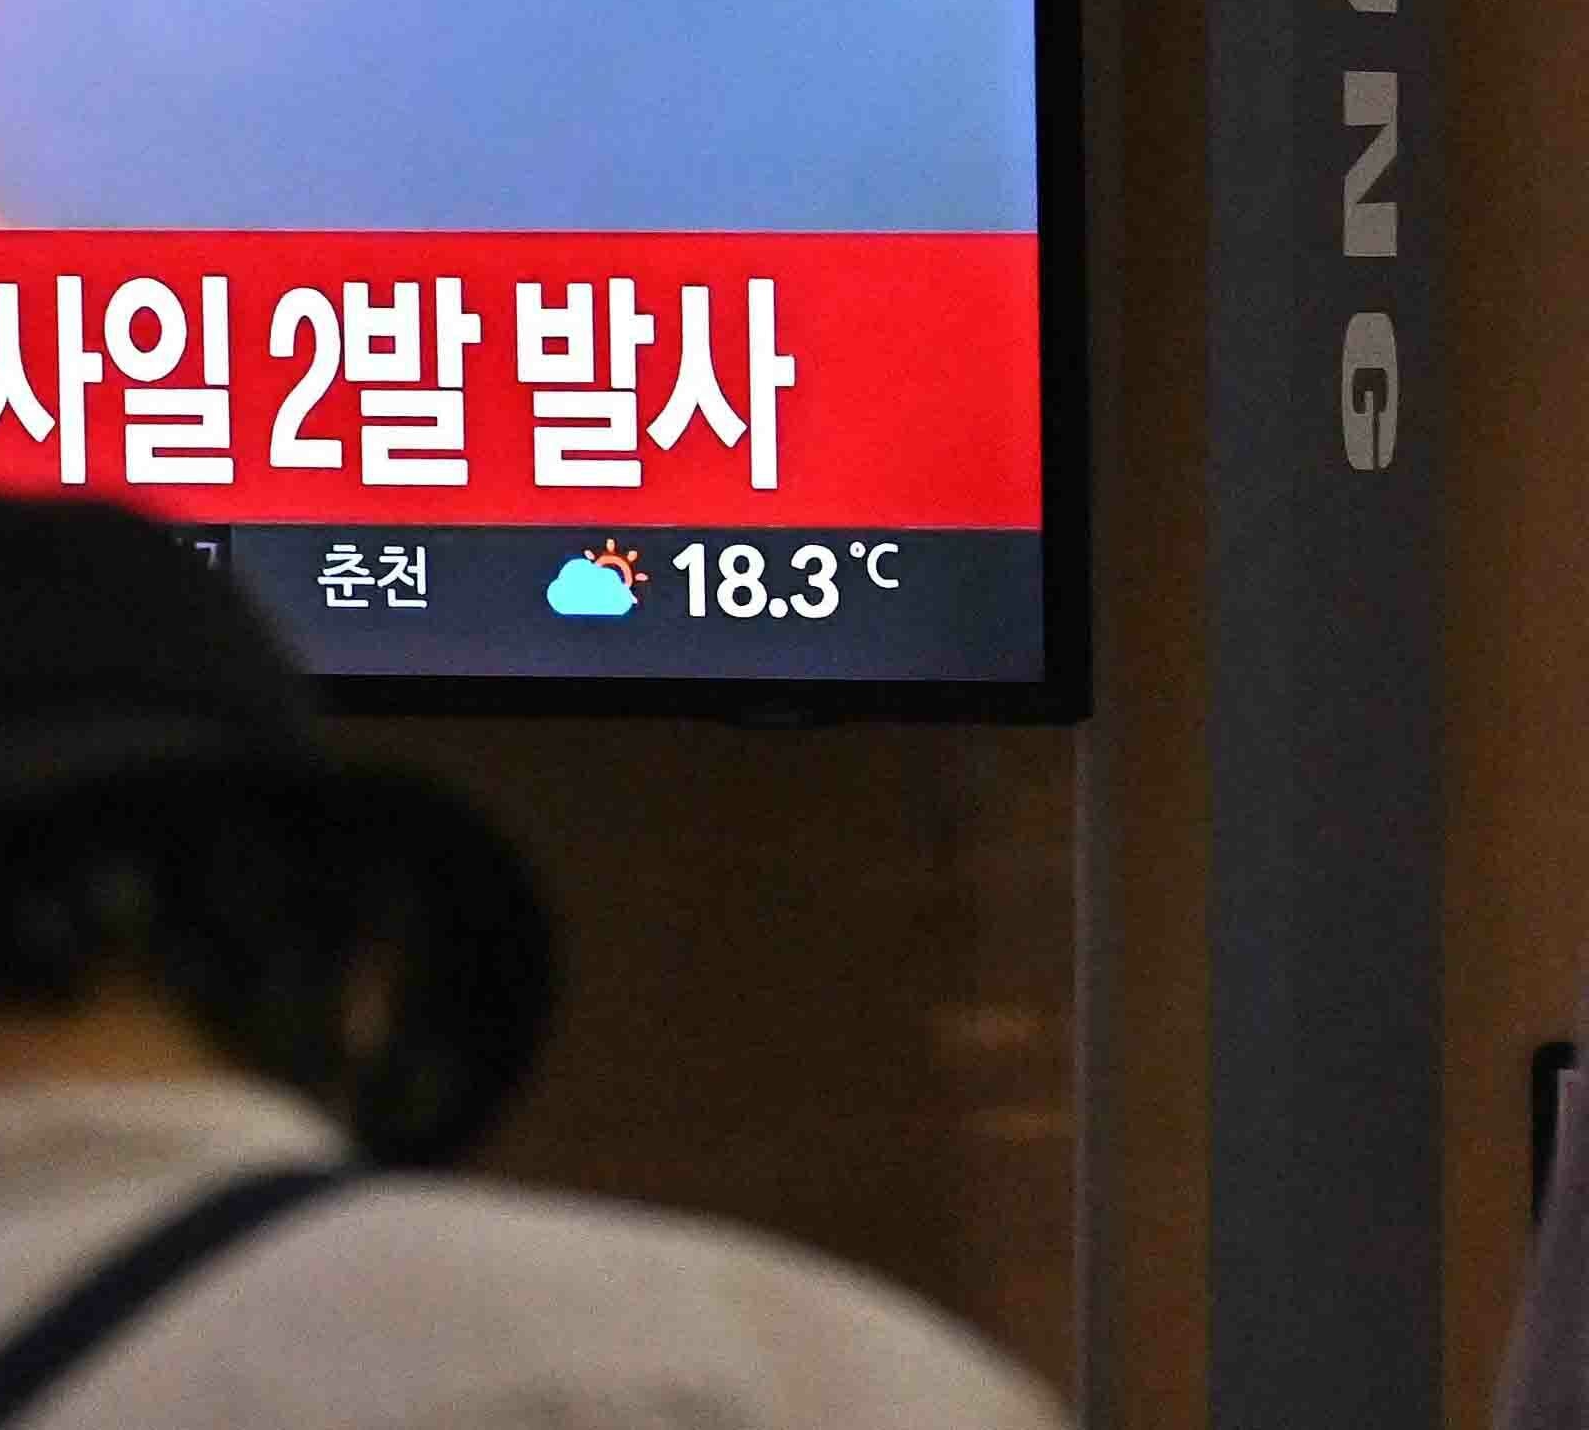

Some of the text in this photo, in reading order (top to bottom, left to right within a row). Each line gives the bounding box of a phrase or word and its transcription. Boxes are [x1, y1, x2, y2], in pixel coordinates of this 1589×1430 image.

[269, 277, 481, 486] 2발
[516, 278, 795, 489] 발사
[317, 544, 428, 608] 춘천
